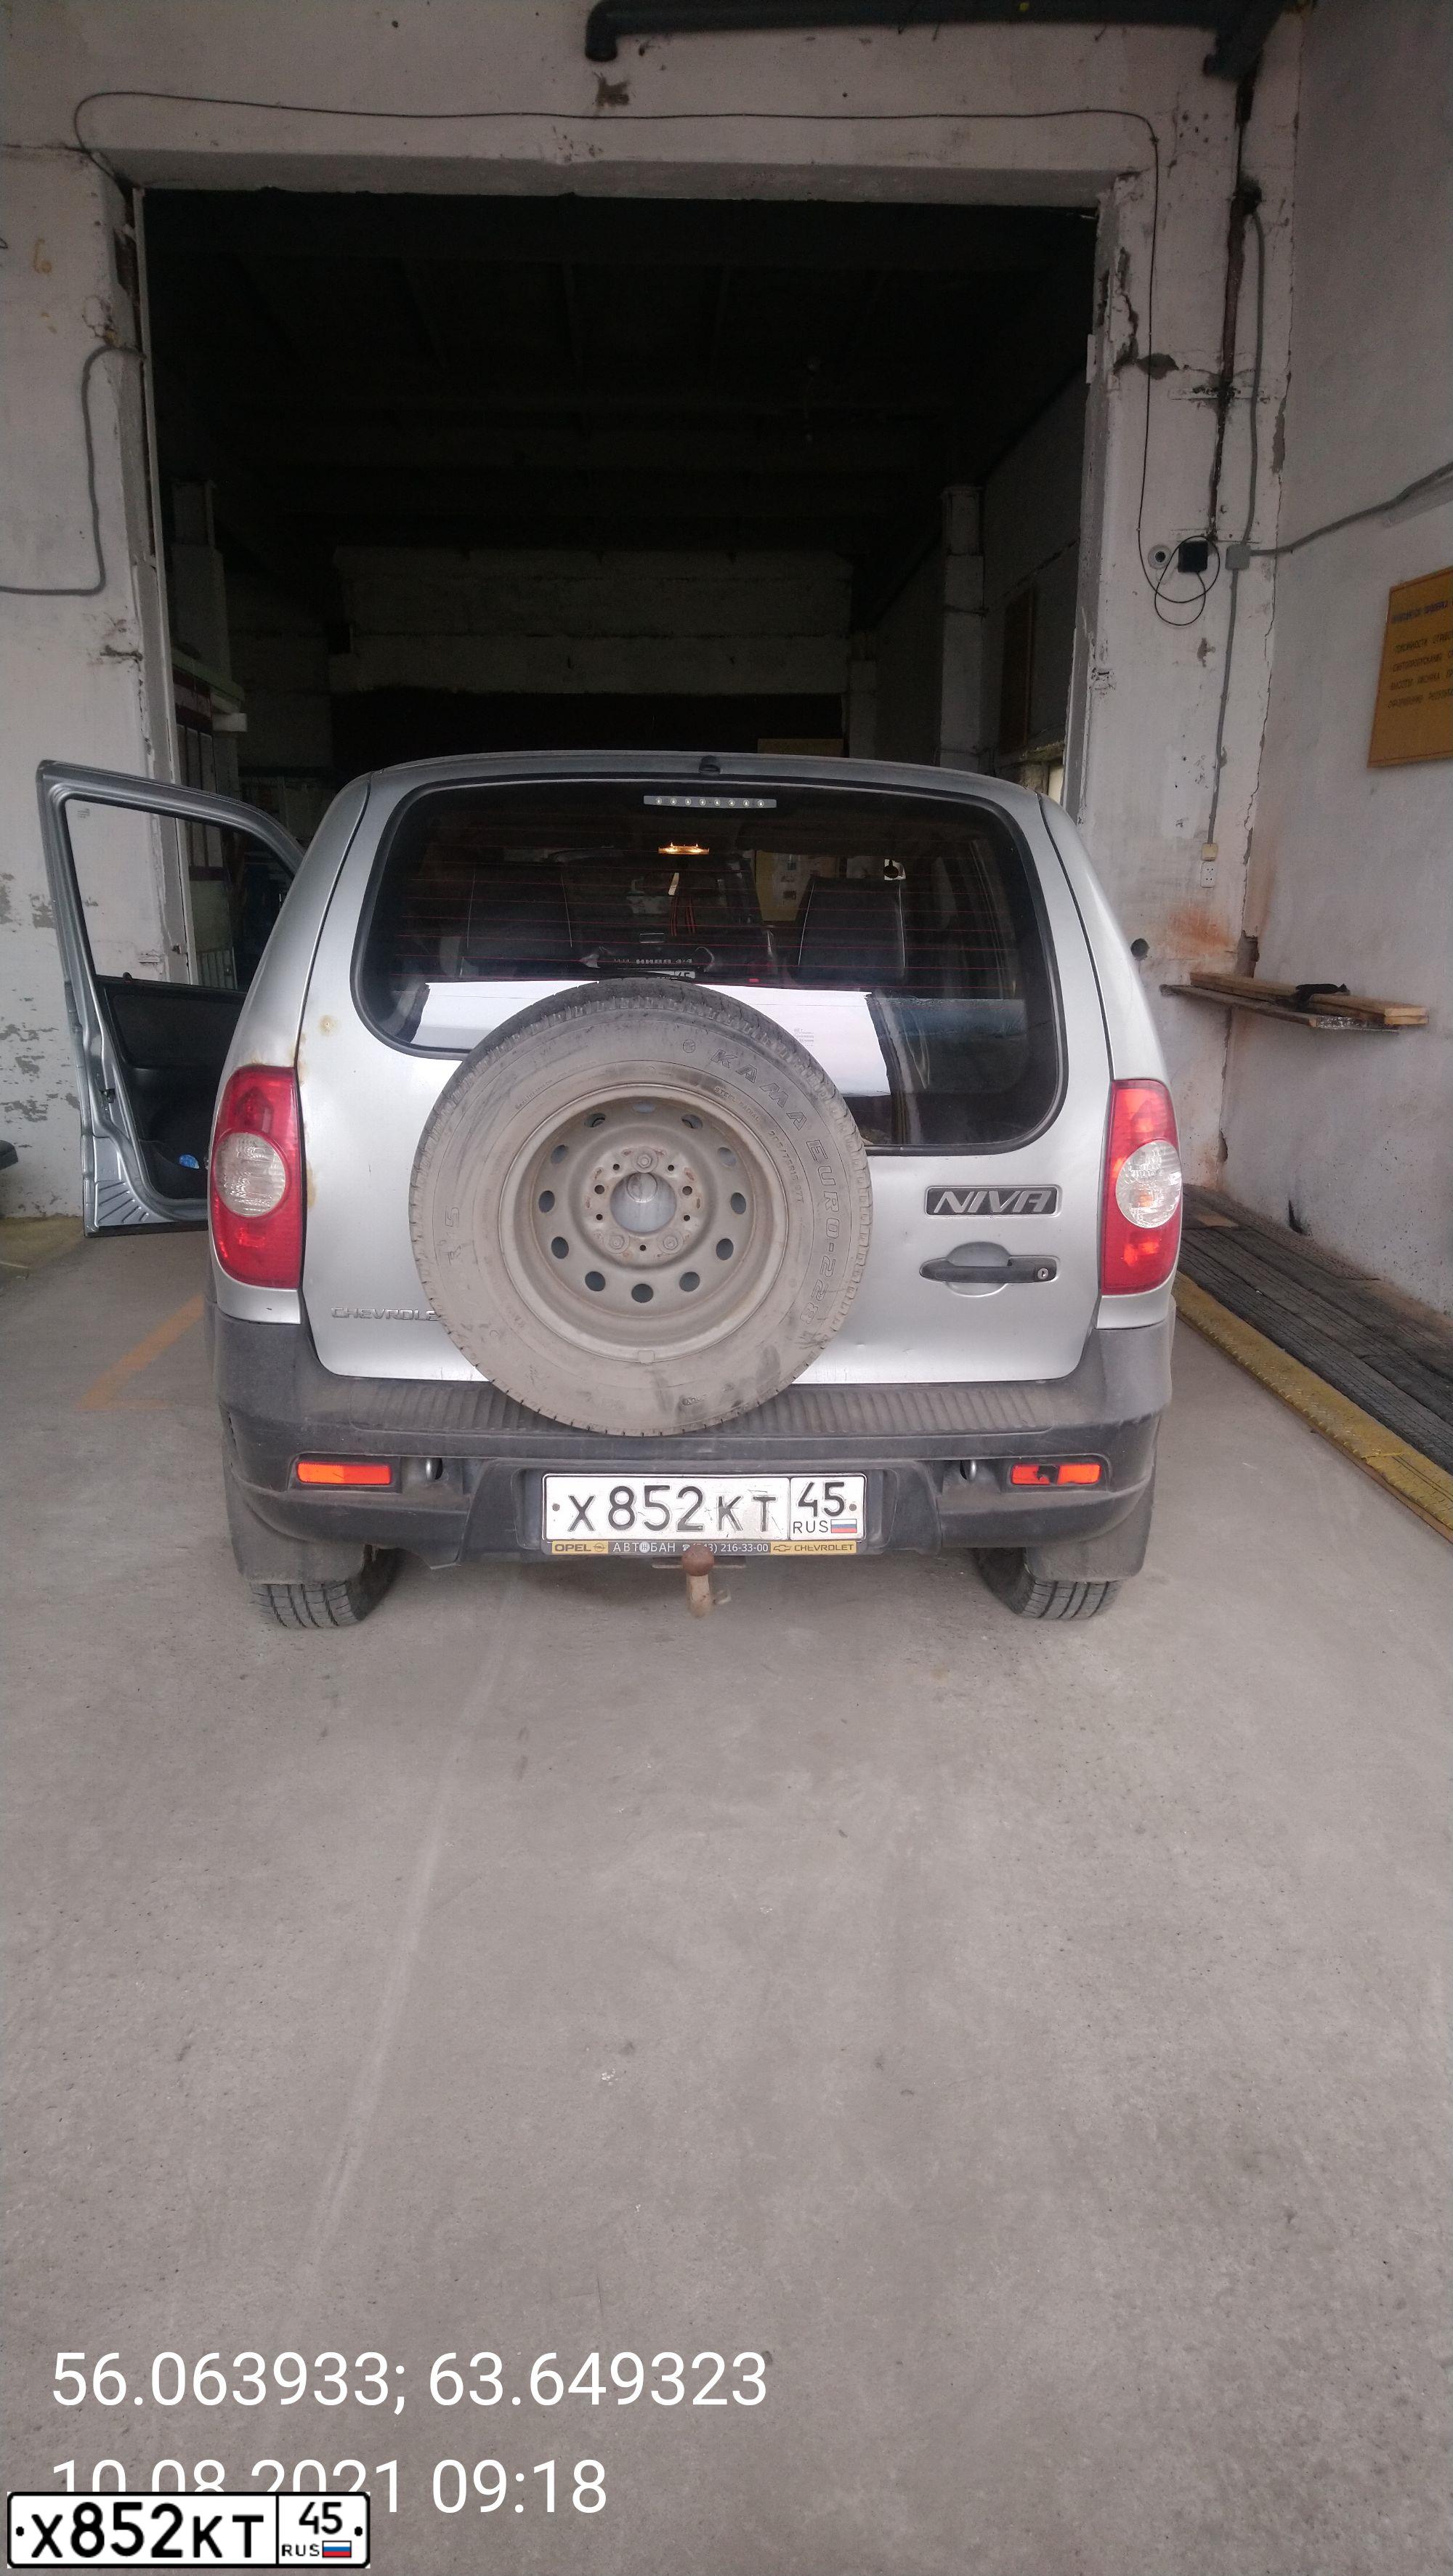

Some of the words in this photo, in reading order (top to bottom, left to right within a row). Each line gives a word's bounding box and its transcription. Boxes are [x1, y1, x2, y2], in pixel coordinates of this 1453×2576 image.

[711, 1049, 807, 1131] KAMA
[800, 1139, 840, 1324] EURO-228
[934, 1190, 1052, 1214] NIVA
[331, 1307, 440, 1321] CHEVROLE
[567, 1485, 777, 1532] Х852КТ
[798, 1482, 846, 1517] 45
[793, 1520, 829, 1533] RUS
[554, 1543, 591, 1552] OPEL
[721, 1543, 769, 1552] 216-33-00
